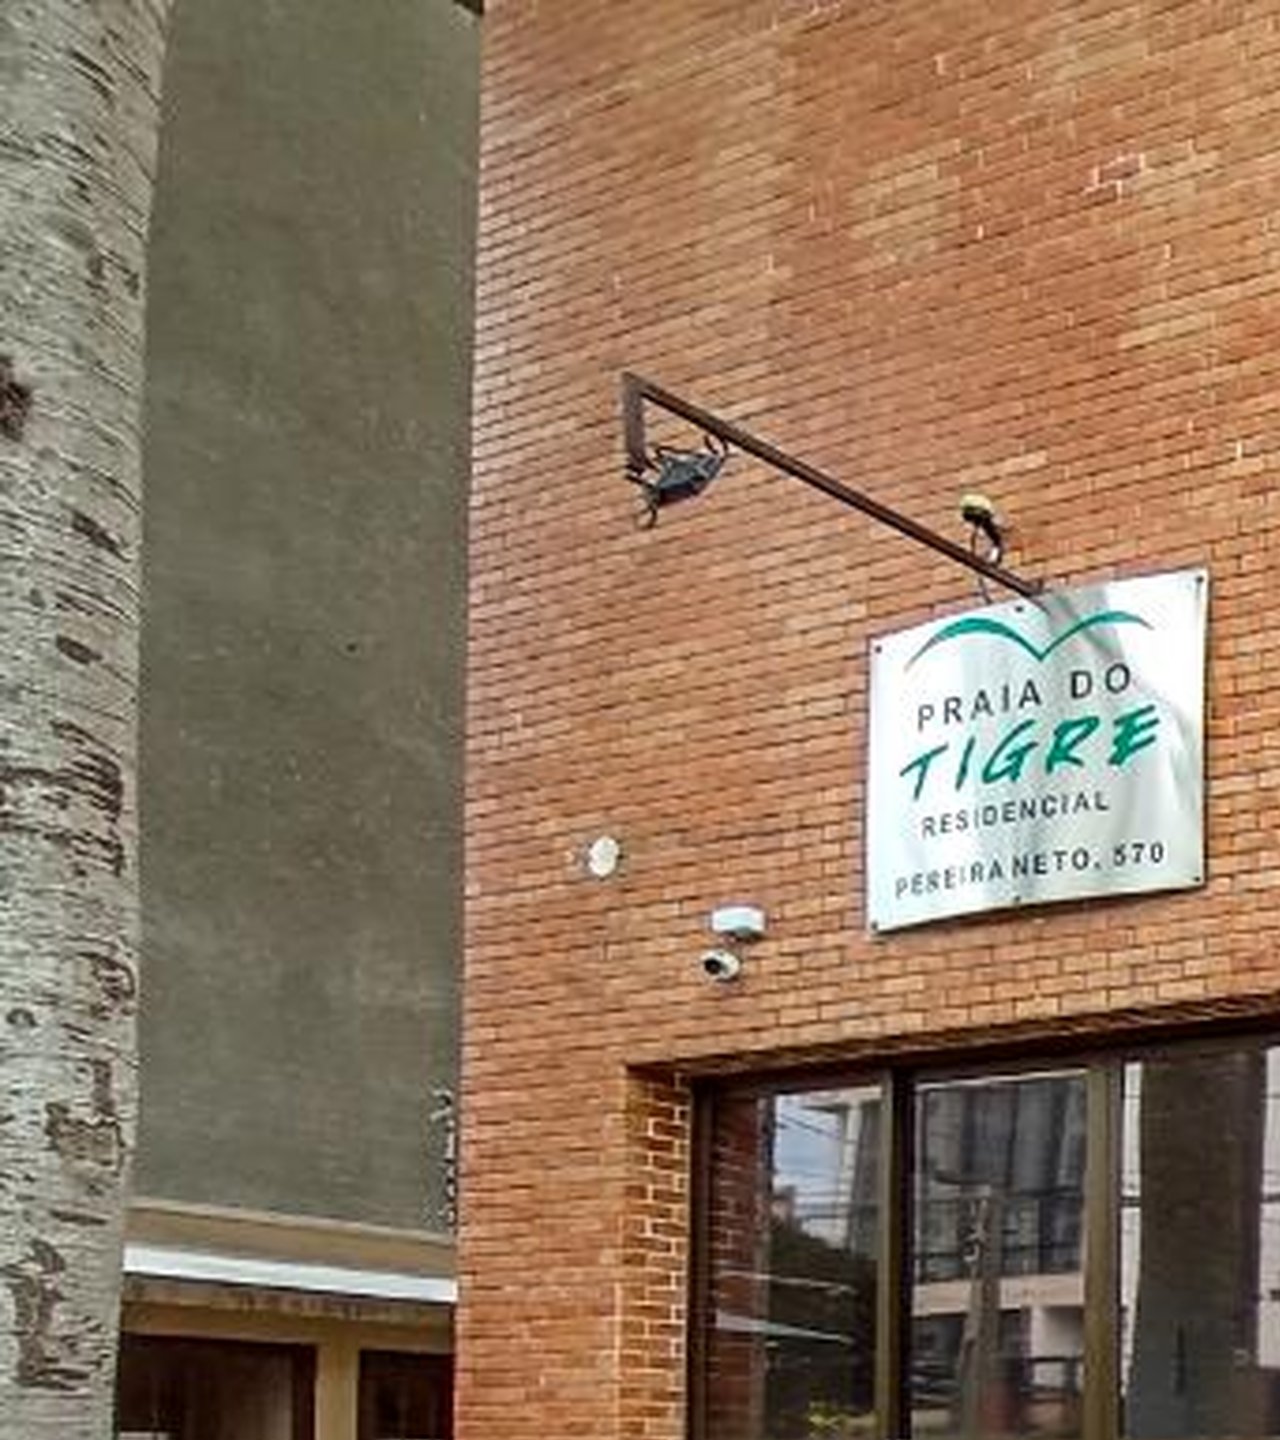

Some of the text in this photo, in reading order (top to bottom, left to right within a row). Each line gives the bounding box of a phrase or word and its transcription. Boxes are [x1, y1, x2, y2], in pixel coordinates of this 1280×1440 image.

[917, 663, 1131, 732] PRAIA DO
[899, 704, 1160, 800] TIGRE
[921, 791, 1109, 839] RESIDENCIAL
[1113, 842, 1165, 868] 570
